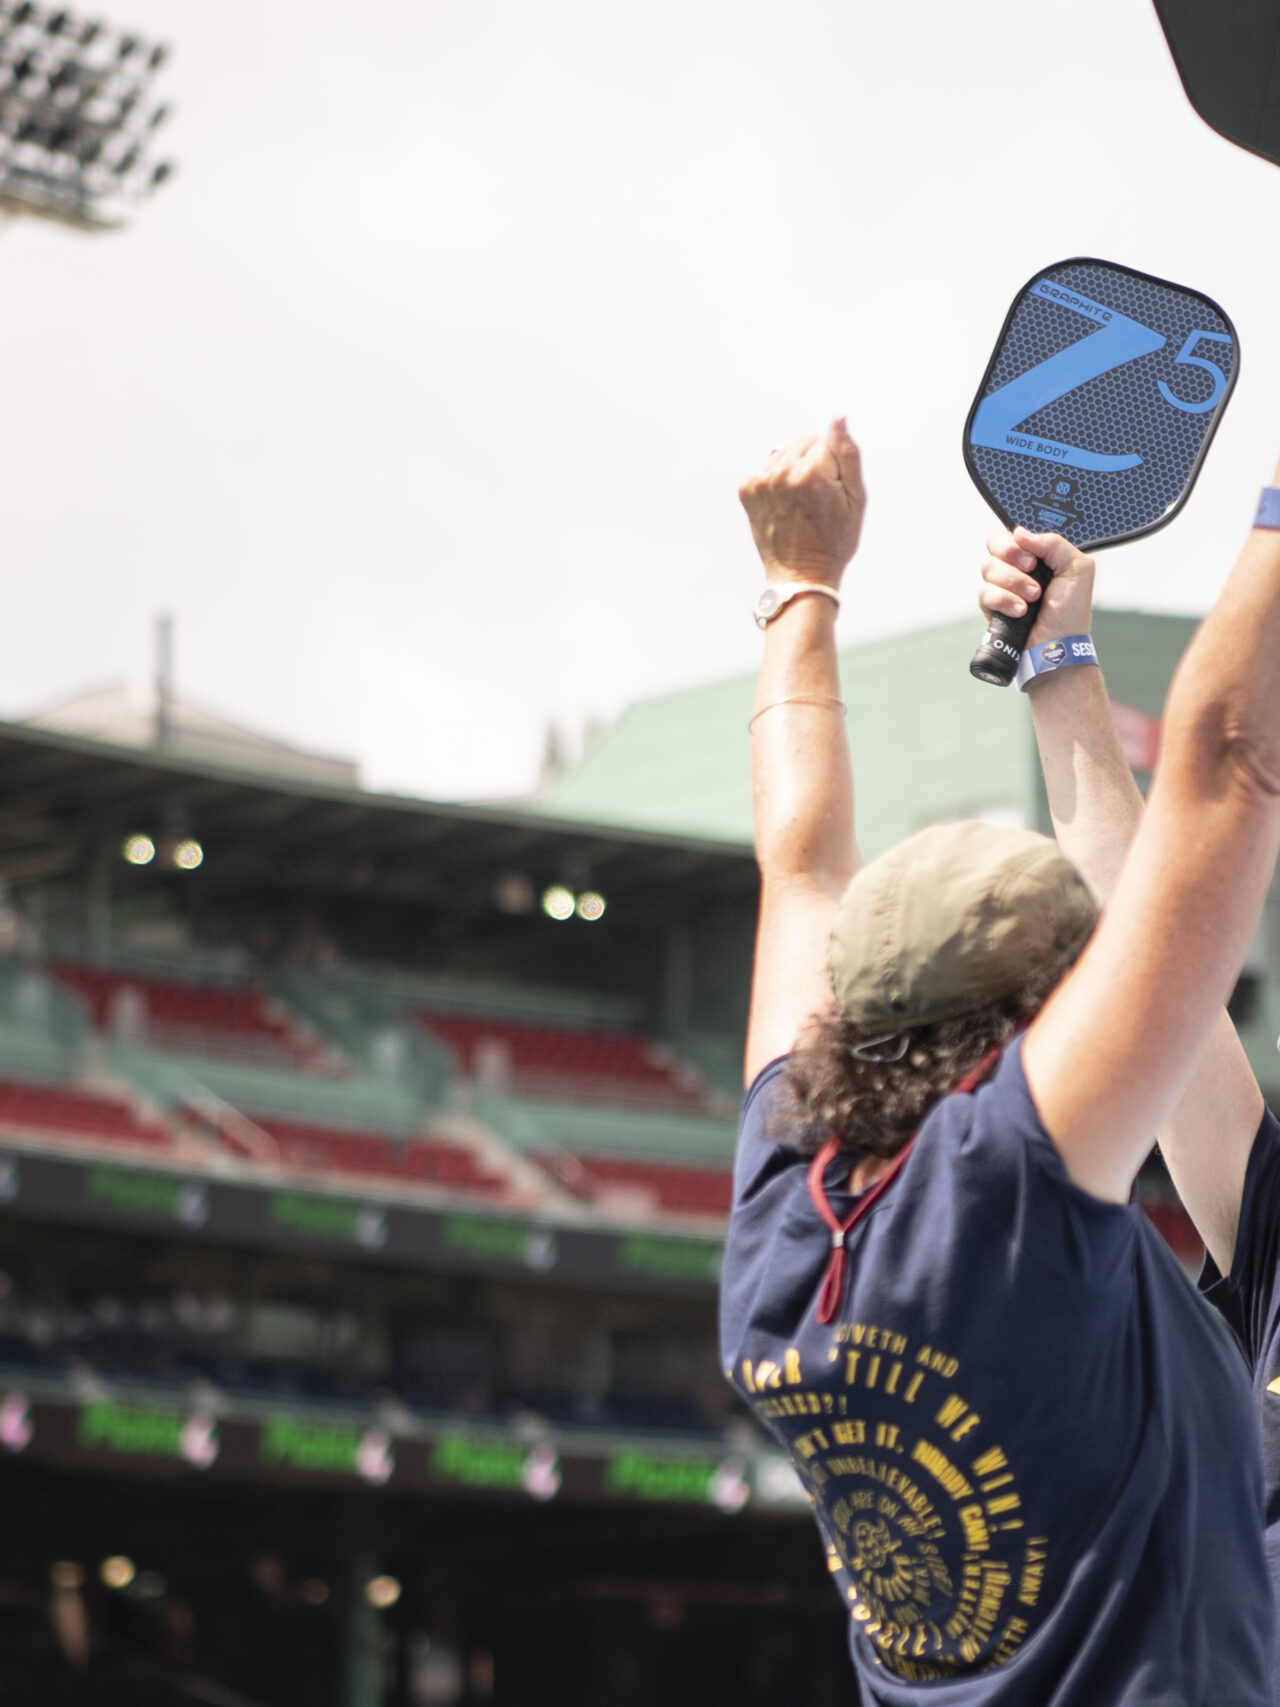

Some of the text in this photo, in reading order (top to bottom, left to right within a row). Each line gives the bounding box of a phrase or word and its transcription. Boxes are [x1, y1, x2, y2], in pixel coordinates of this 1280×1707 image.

[1039, 283, 1113, 323] GRAPHITE
[1005, 435, 1069, 459] WIDE BODY
[915, 1345, 959, 1378] AND
[831, 1419, 866, 1445] GET
[911, 1438, 974, 1501] NOBODY
[934, 1393, 981, 1443] WE
[970, 1444, 1025, 1533] WIN!
[1017, 1536, 1048, 1607] AWAY!
